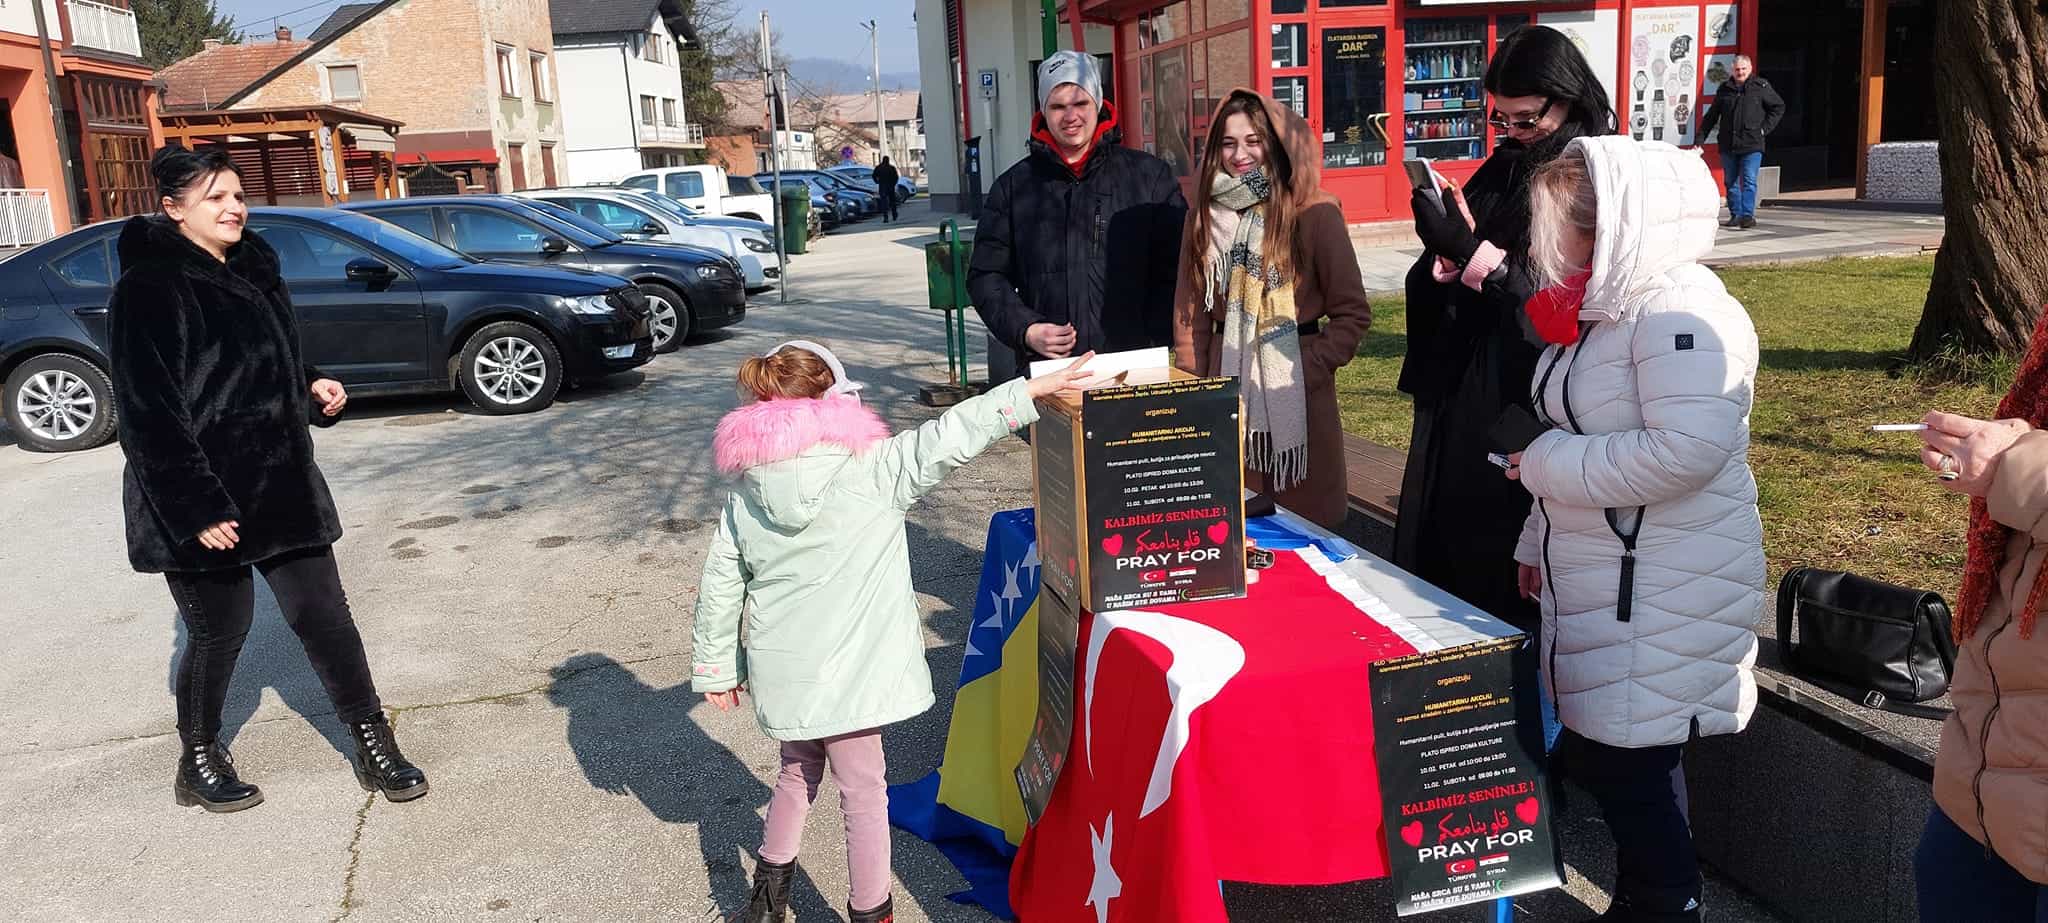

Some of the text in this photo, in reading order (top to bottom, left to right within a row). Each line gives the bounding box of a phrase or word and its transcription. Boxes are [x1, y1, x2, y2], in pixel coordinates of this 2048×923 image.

[984, 74, 991, 84] P
[1145, 408, 1177, 416] organizuju
[1178, 466, 1201, 474] KULTURE
[1104, 506, 1228, 529] KALBİMİZ SENİNLE !
[1116, 548, 1221, 570] PRAY FOR
[1437, 674, 1471, 686] organizuju
[1424, 692, 1492, 710] HUMANITARNU AKCIJU
[1420, 737, 1503, 759] PLATO ISPRED DOMA KULTURE
[1439, 762, 1457, 771] PETAK
[1443, 776, 1466, 786] SUBOTA
[1400, 780, 1535, 816] KALBİMİZ SENİNLE !
[1417, 829, 1534, 863] PRAY FOR
[1486, 867, 1507, 876] SYRIA
[1410, 890, 1431, 902] NAŠA
[1432, 888, 1451, 898] SRCA
[1452, 885, 1463, 894] SU
[1471, 880, 1492, 891] VAMA
